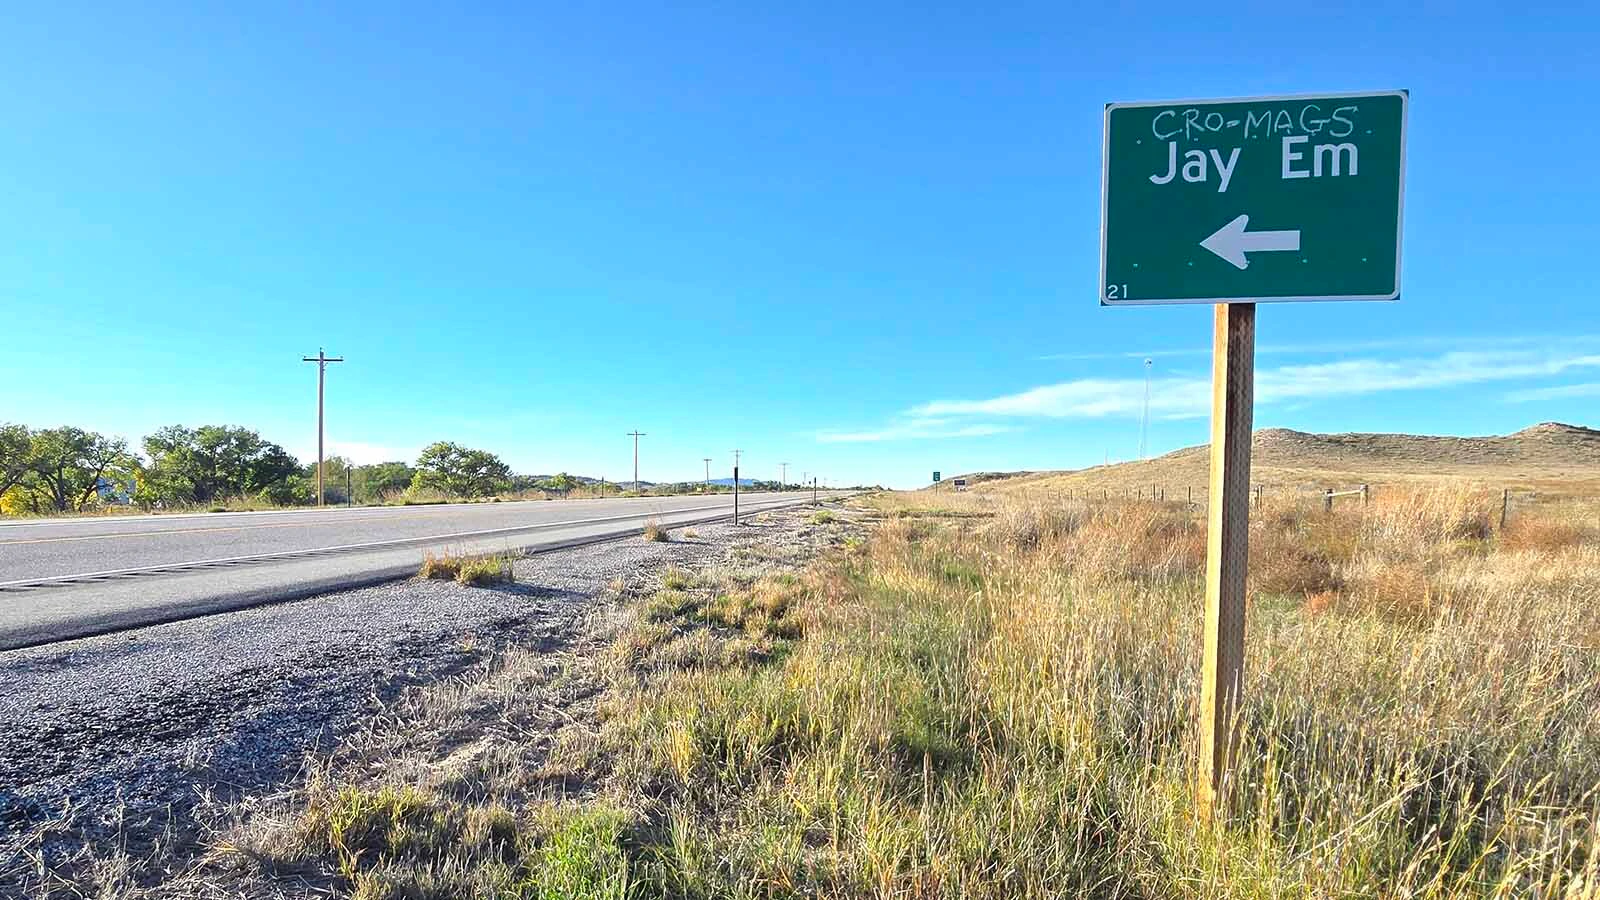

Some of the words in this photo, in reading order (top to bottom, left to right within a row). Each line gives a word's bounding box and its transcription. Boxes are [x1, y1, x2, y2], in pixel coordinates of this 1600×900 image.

[1152, 105, 1358, 139] CRO-MAGS
[1149, 141, 1241, 192] Jay
[1282, 136, 1358, 179] Em
[1107, 284, 1128, 299] 21
